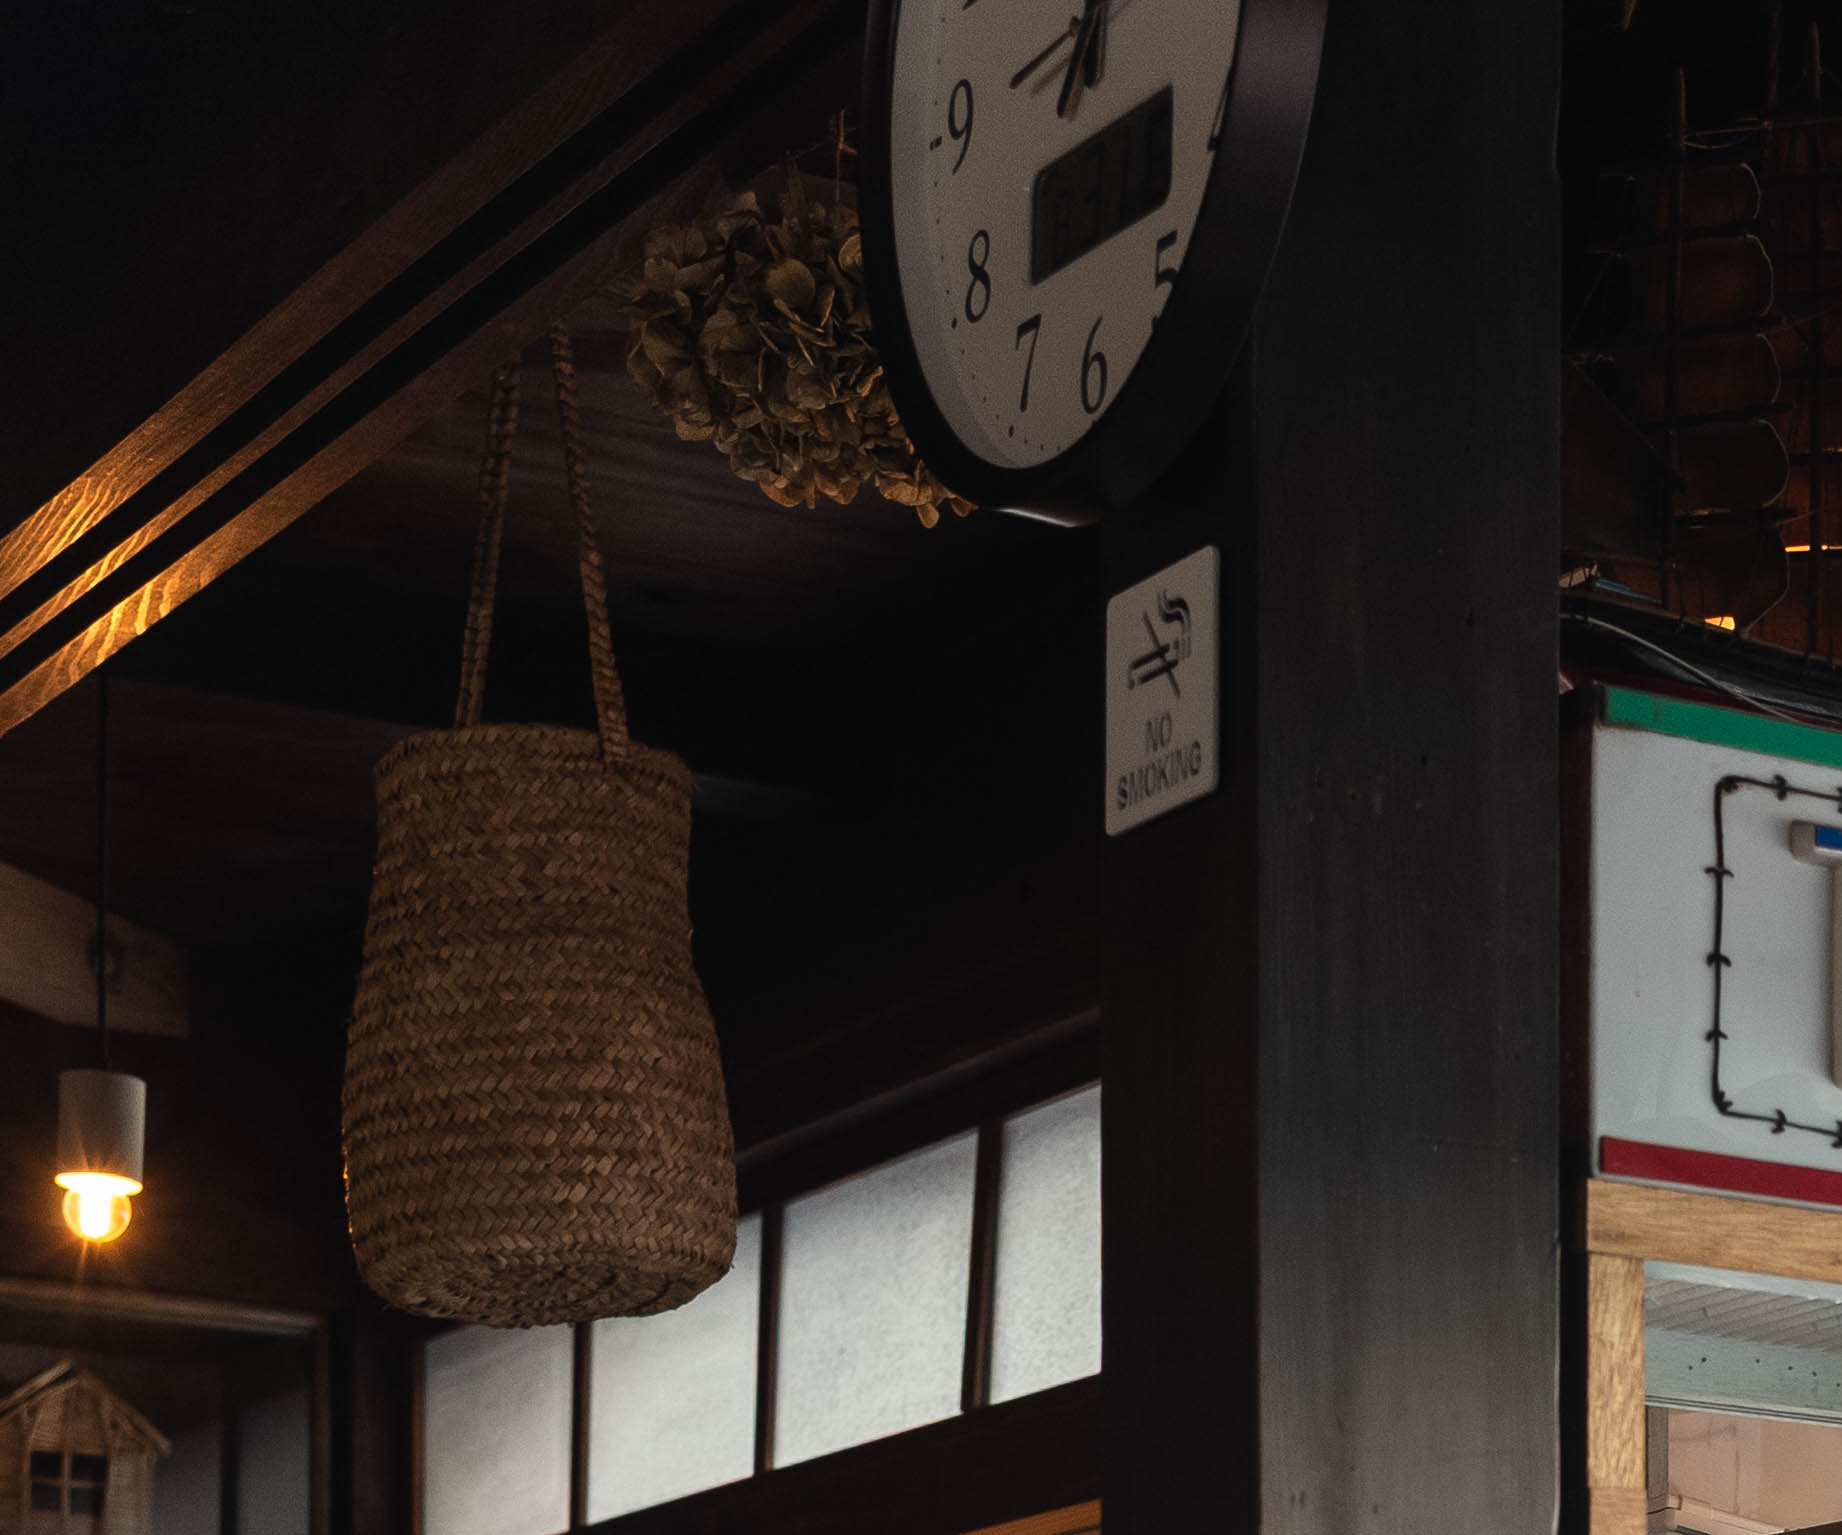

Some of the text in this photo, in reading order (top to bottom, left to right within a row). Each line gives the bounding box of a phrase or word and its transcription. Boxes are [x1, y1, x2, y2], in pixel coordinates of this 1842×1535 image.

[947, 79, 974, 175] 9
[964, 229, 992, 324] 8
[1015, 313, 1042, 413] 7
[1081, 315, 1108, 415] 6
[1117, 741, 1202, 810] SMOKING
[1144, 711, 1172, 753] NO
